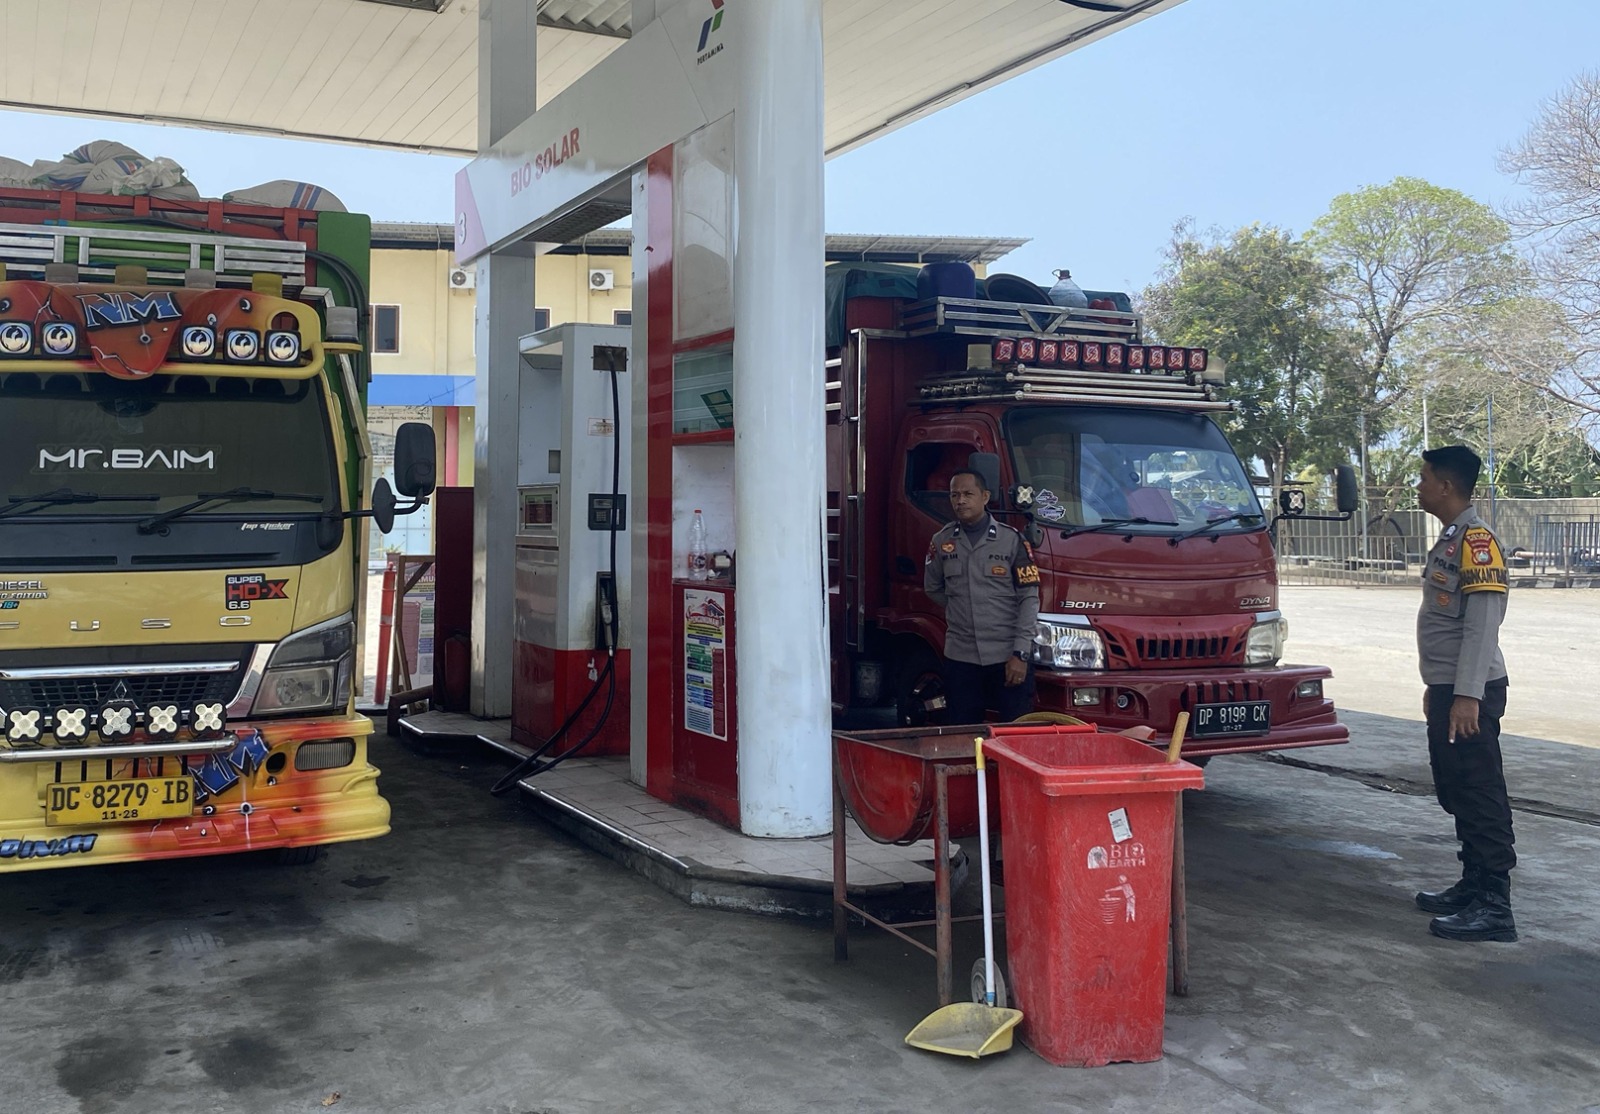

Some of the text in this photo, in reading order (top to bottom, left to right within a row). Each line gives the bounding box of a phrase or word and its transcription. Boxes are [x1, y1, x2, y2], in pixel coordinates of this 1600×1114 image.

[697, 43, 724, 66] PERTAMINA
[511, 127, 580, 197] BIO SOLAR
[458, 211, 468, 246] 3
[76, 291, 182, 327] NM
[227, 575, 263, 584] SUPER
[228, 582, 287, 600] HD-X
[228, 600, 250, 610] 6.6
[1060, 600, 1106, 609] 130HT
[1240, 596, 1271, 606] DYNA
[1199, 704, 1267, 726] DP 8198 CK
[51, 780, 190, 812] DC 8279 IB
[1110, 842, 1145, 859] BIO
[1108, 857, 1146, 868] EARTH
